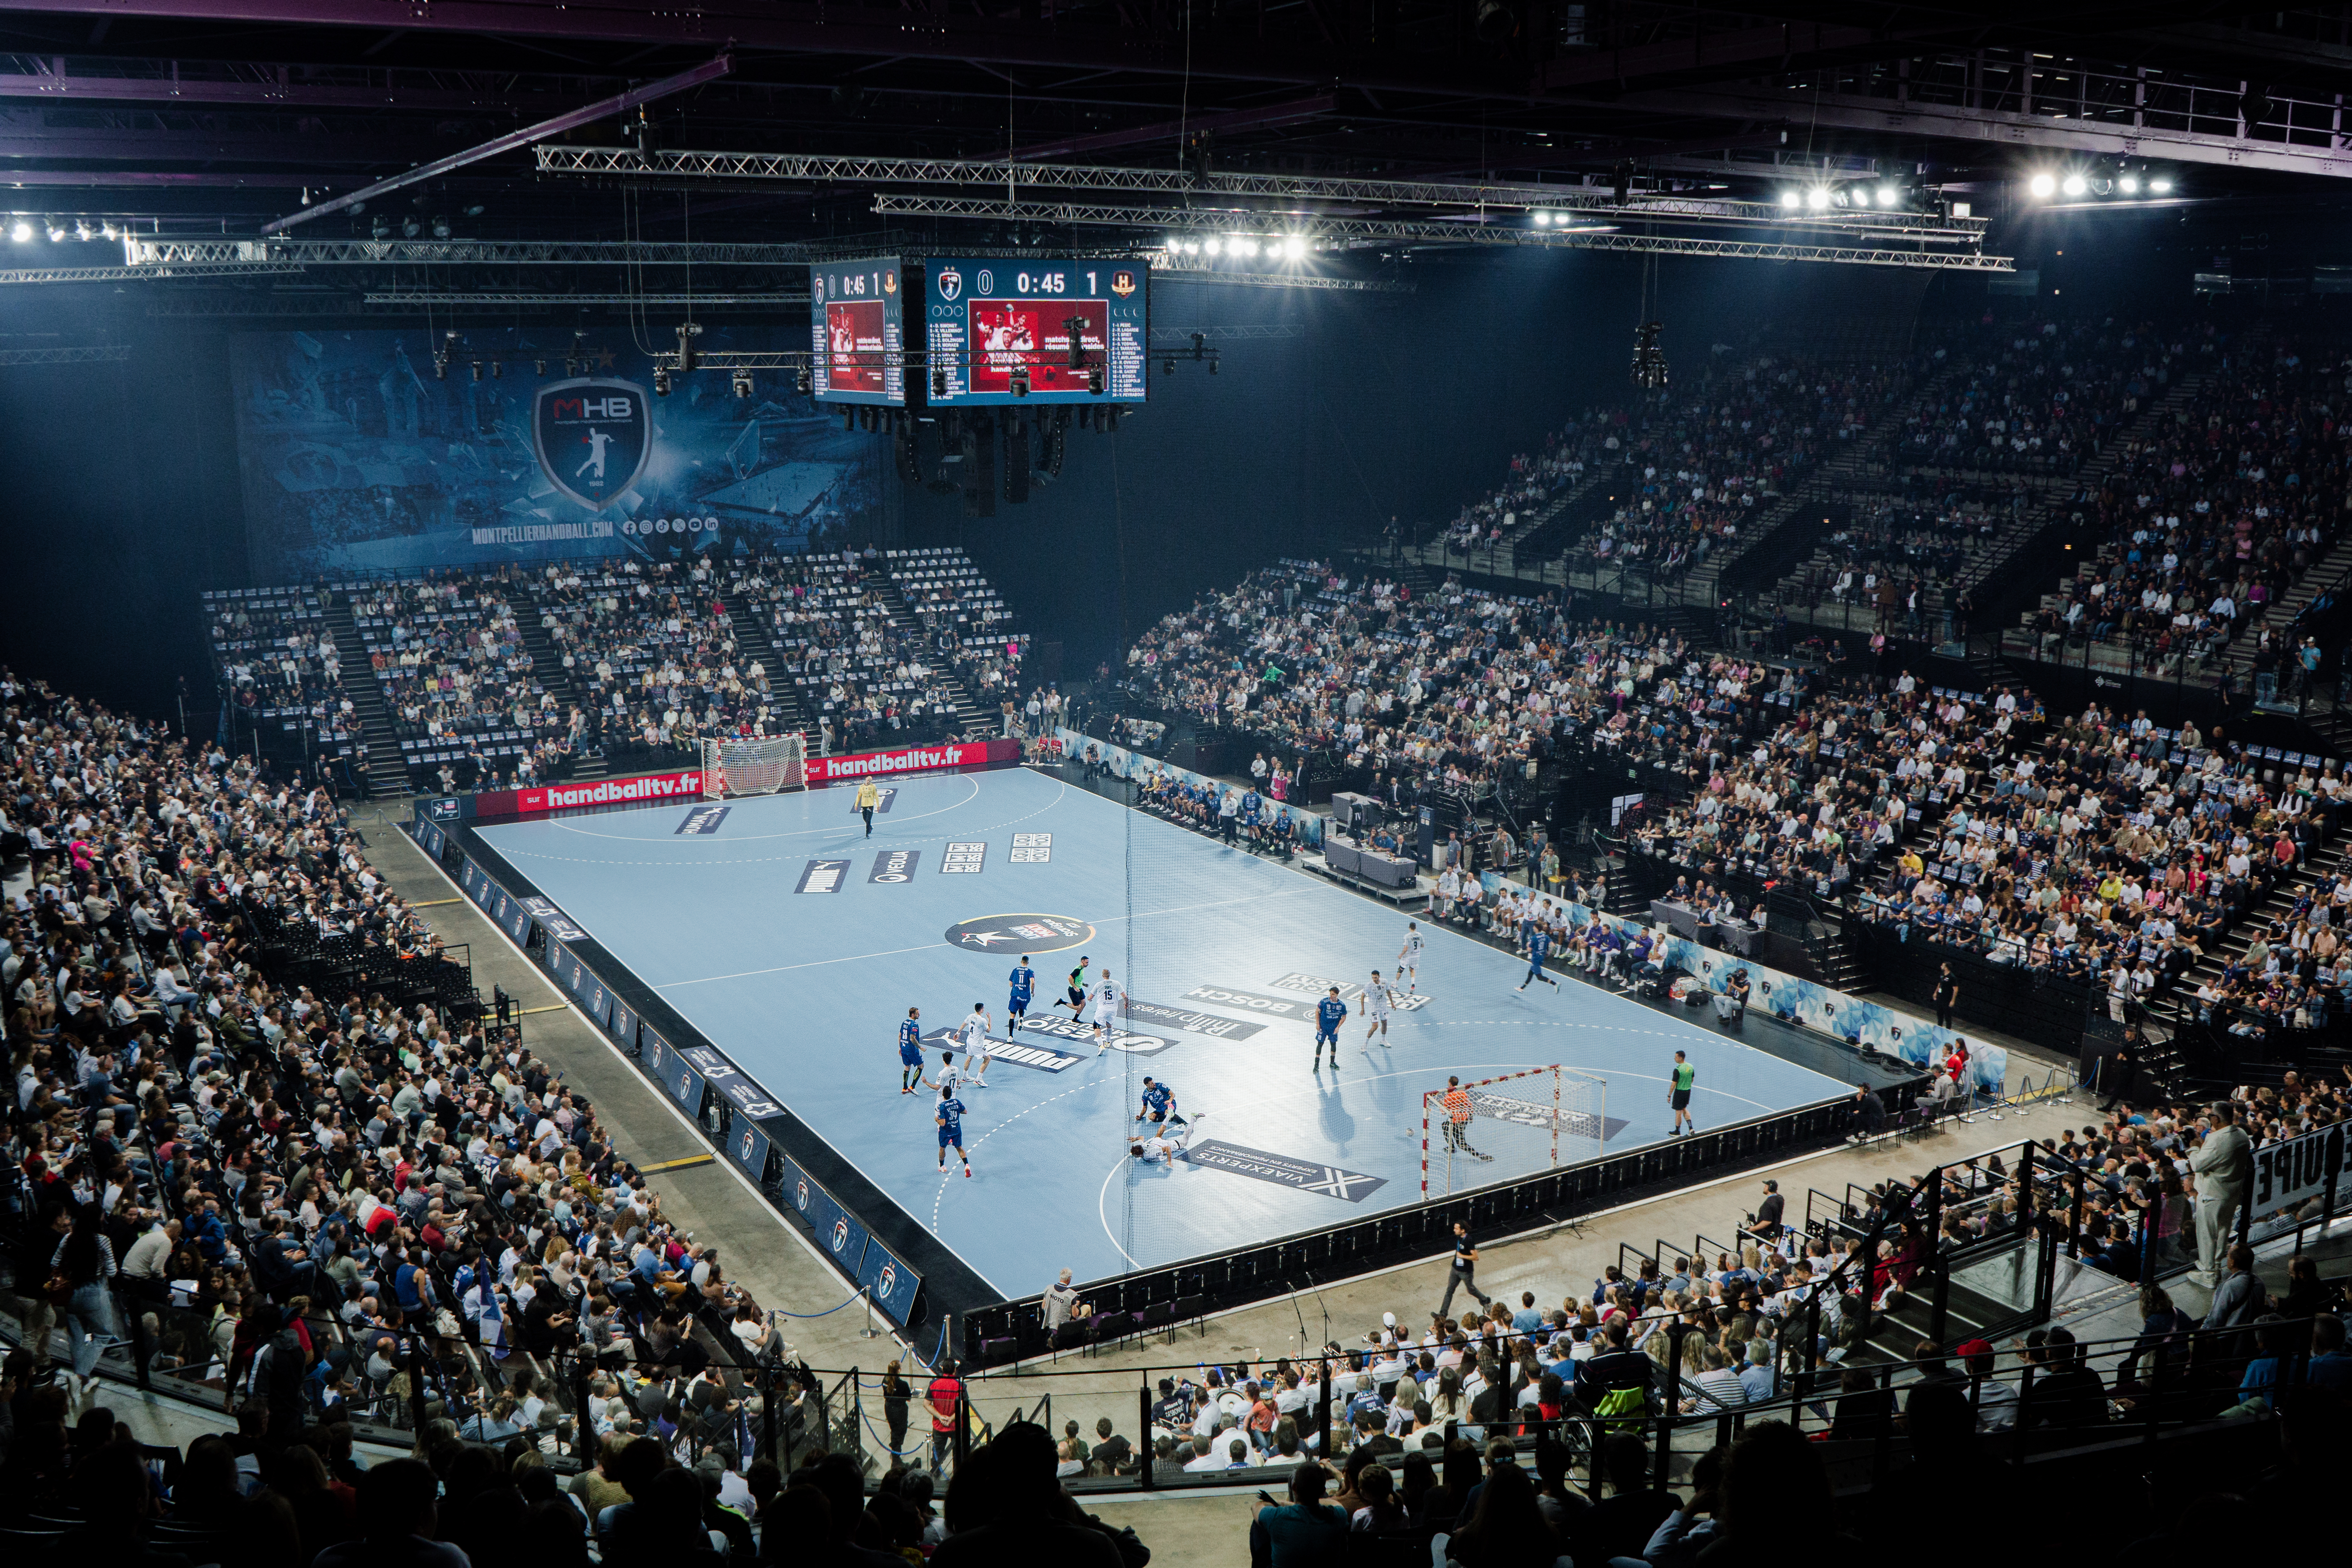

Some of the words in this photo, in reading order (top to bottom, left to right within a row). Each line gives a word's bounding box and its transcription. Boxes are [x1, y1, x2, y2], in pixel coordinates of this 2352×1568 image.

[829, 274, 835, 298] 0
[844, 275, 865, 295] 0:45
[873, 272, 879, 295] 1
[978, 270, 993, 295] 0
[1017, 273, 1065, 293] 0:45
[1087, 272, 1096, 295] 1
[553, 397, 632, 419] MHB
[472, 521, 613, 545] MONTPELLIERHANDBALL.COM
[827, 746, 962, 777] handballtv.fr
[548, 773, 699, 806] handballtv.fr
[681, 815, 710, 834] HUMAN
[1016, 834, 1031, 846] LIQUI
[1034, 834, 1049, 846] MOLY
[1013, 849, 1029, 862] LIQUI
[1032, 848, 1047, 861] MOLY
[885, 851, 910, 874] VEOLIA
[803, 869, 840, 893] PUMA
[1013, 926, 1041, 939] LIQUI
[1024, 923, 1057, 937] MOLY
[1042, 918, 1078, 937] Starligue
[1413, 941, 1417, 950] 9
[1019, 974, 1025, 984] 11
[1288, 975, 1348, 990] MOLY
[1104, 990, 1113, 1000] 15
[1280, 980, 1331, 995] IQUI
[1186, 988, 1295, 1013] BOSCH
[1388, 989, 1424, 1003] MO
[1132, 1004, 1184, 1020] frères
[970, 1026, 973, 1035] 4
[1178, 1013, 1242, 1037] Philip
[949, 1077, 956, 1088] 17
[1210, 1145, 1268, 1162] PERFORMANCE
[1196, 1153, 1304, 1183] VIAEXPERTS
[1282, 1163, 1318, 1173] EXPERTS
[837, 1224, 846, 1237] MHB
[884, 1270, 894, 1282] MHB
[1164, 1401, 1178, 1411] Allianz
[1358, 1396, 1374, 1404] Allianz
